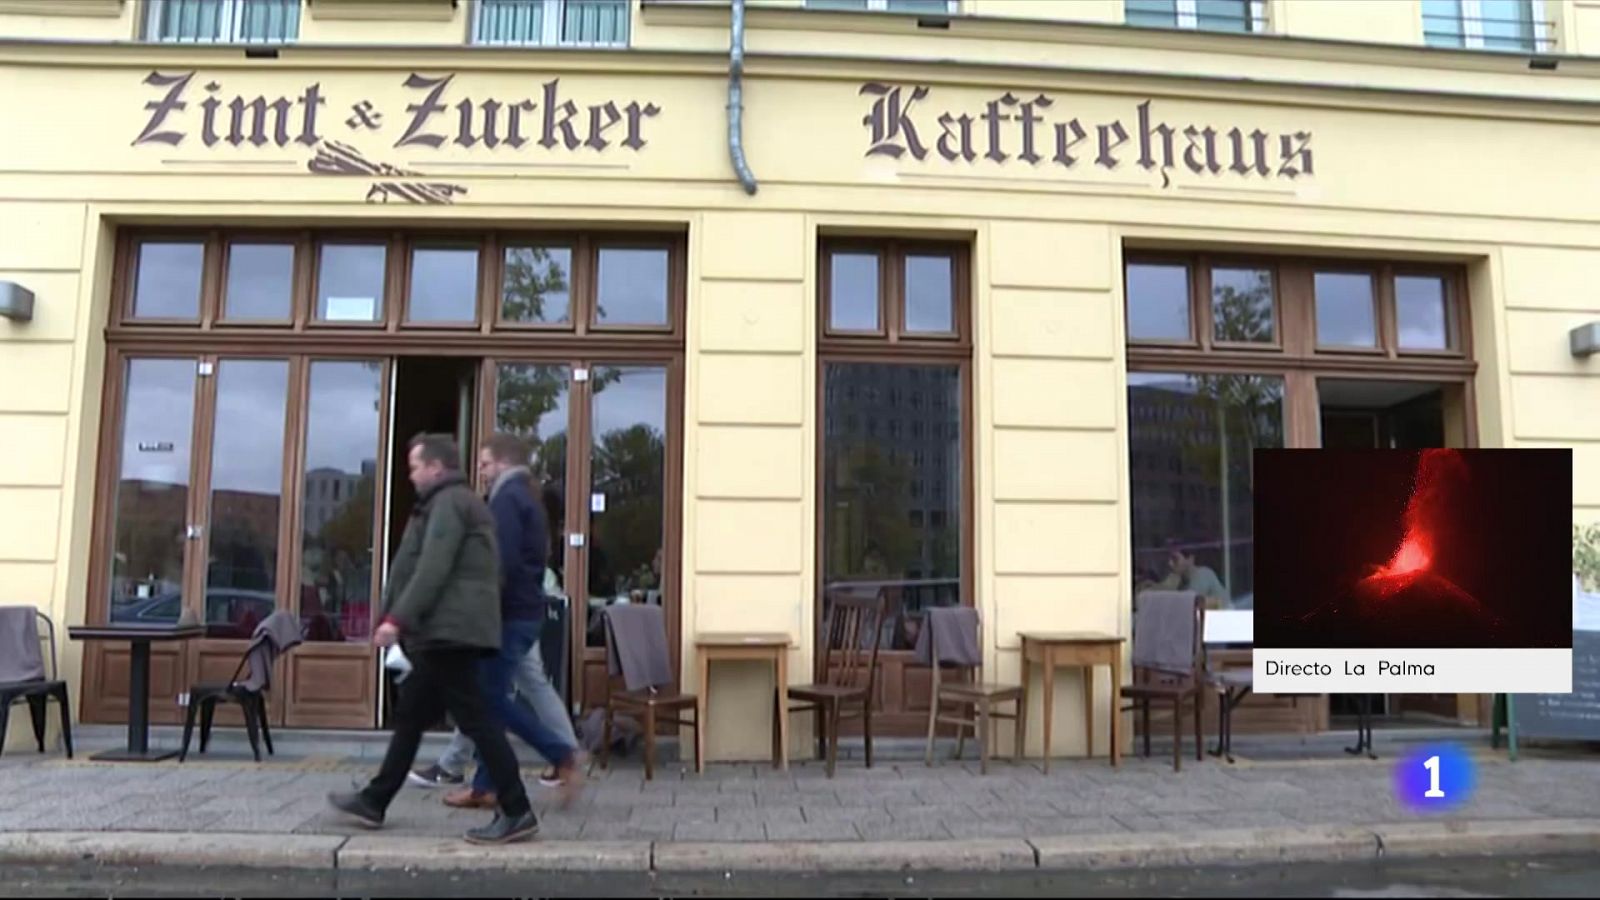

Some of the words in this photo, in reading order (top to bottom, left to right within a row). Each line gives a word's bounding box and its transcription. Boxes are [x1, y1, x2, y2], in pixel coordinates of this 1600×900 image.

[130, 70, 326, 148] Zimt
[345, 100, 383, 130] &
[393, 72, 661, 151] Zucker
[859, 82, 1315, 188] Kaffeehaus
